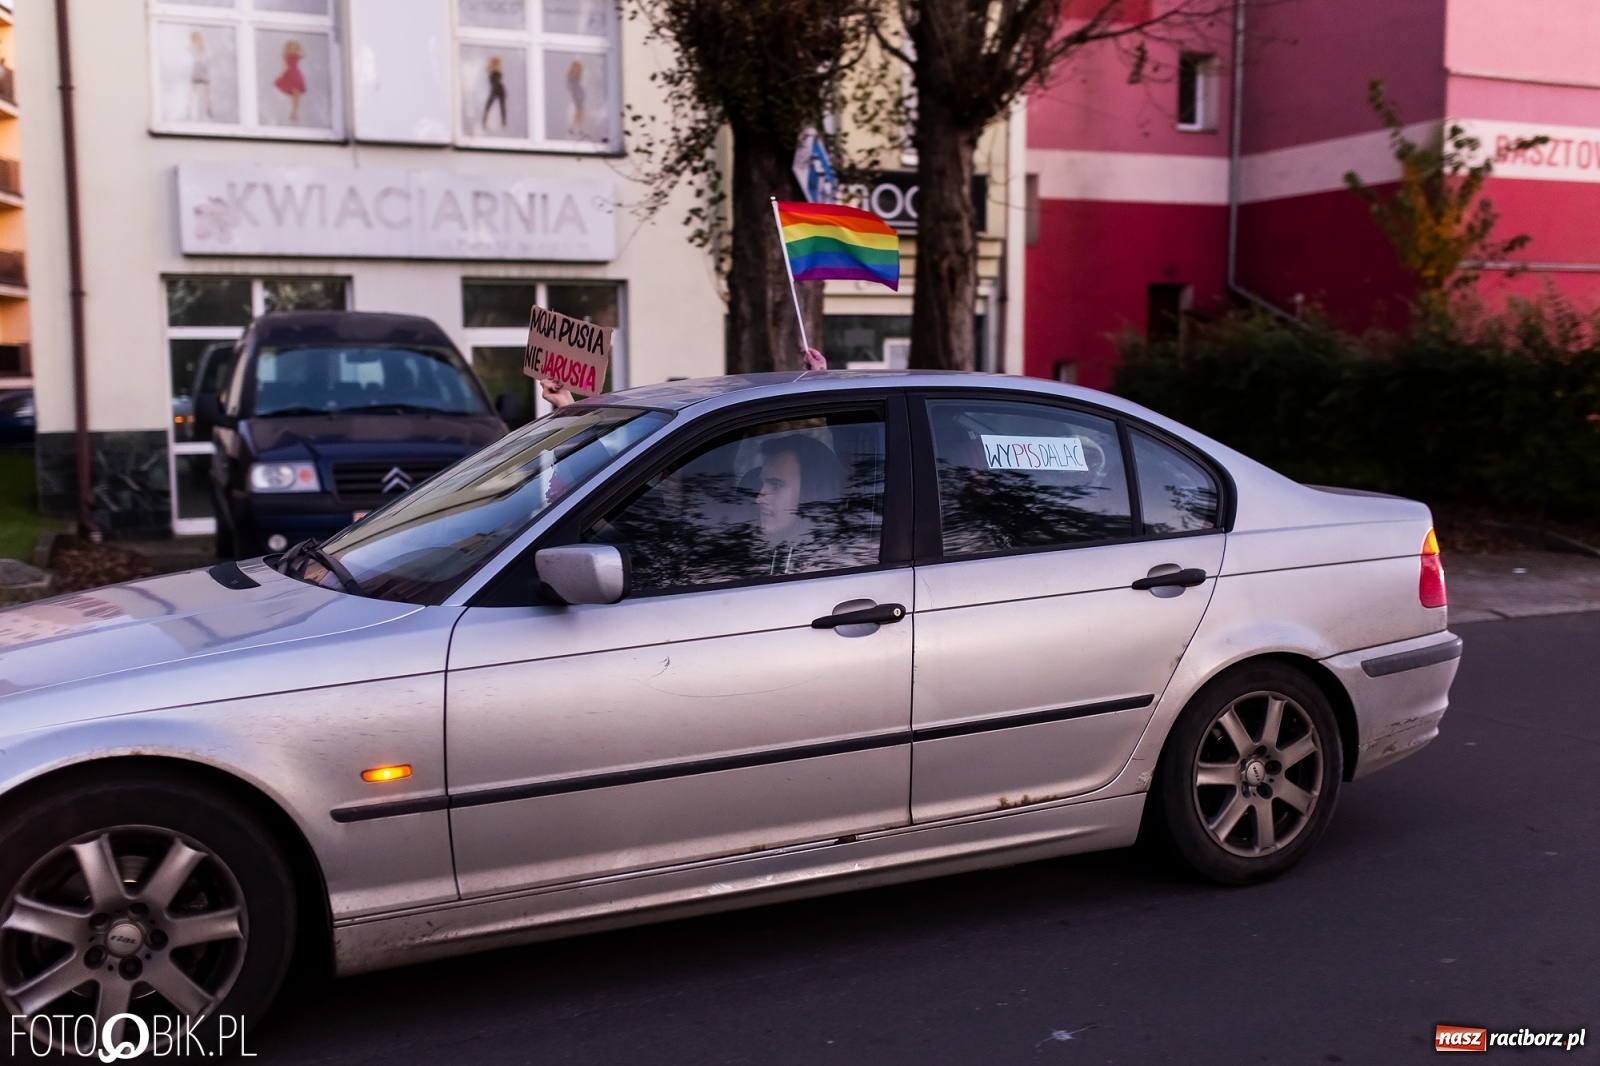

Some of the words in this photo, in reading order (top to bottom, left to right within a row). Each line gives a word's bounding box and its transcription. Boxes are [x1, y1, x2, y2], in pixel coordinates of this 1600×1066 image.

[1495, 134, 1600, 170] BASZTO
[225, 181, 588, 235] KWIACIARNIA
[530, 308, 557, 339] MOJA
[558, 318, 604, 355] PUSIA
[525, 344, 543, 372] NIE
[541, 351, 596, 392] JARUSIA
[985, 440, 1083, 468] WYPISDALAĆ
